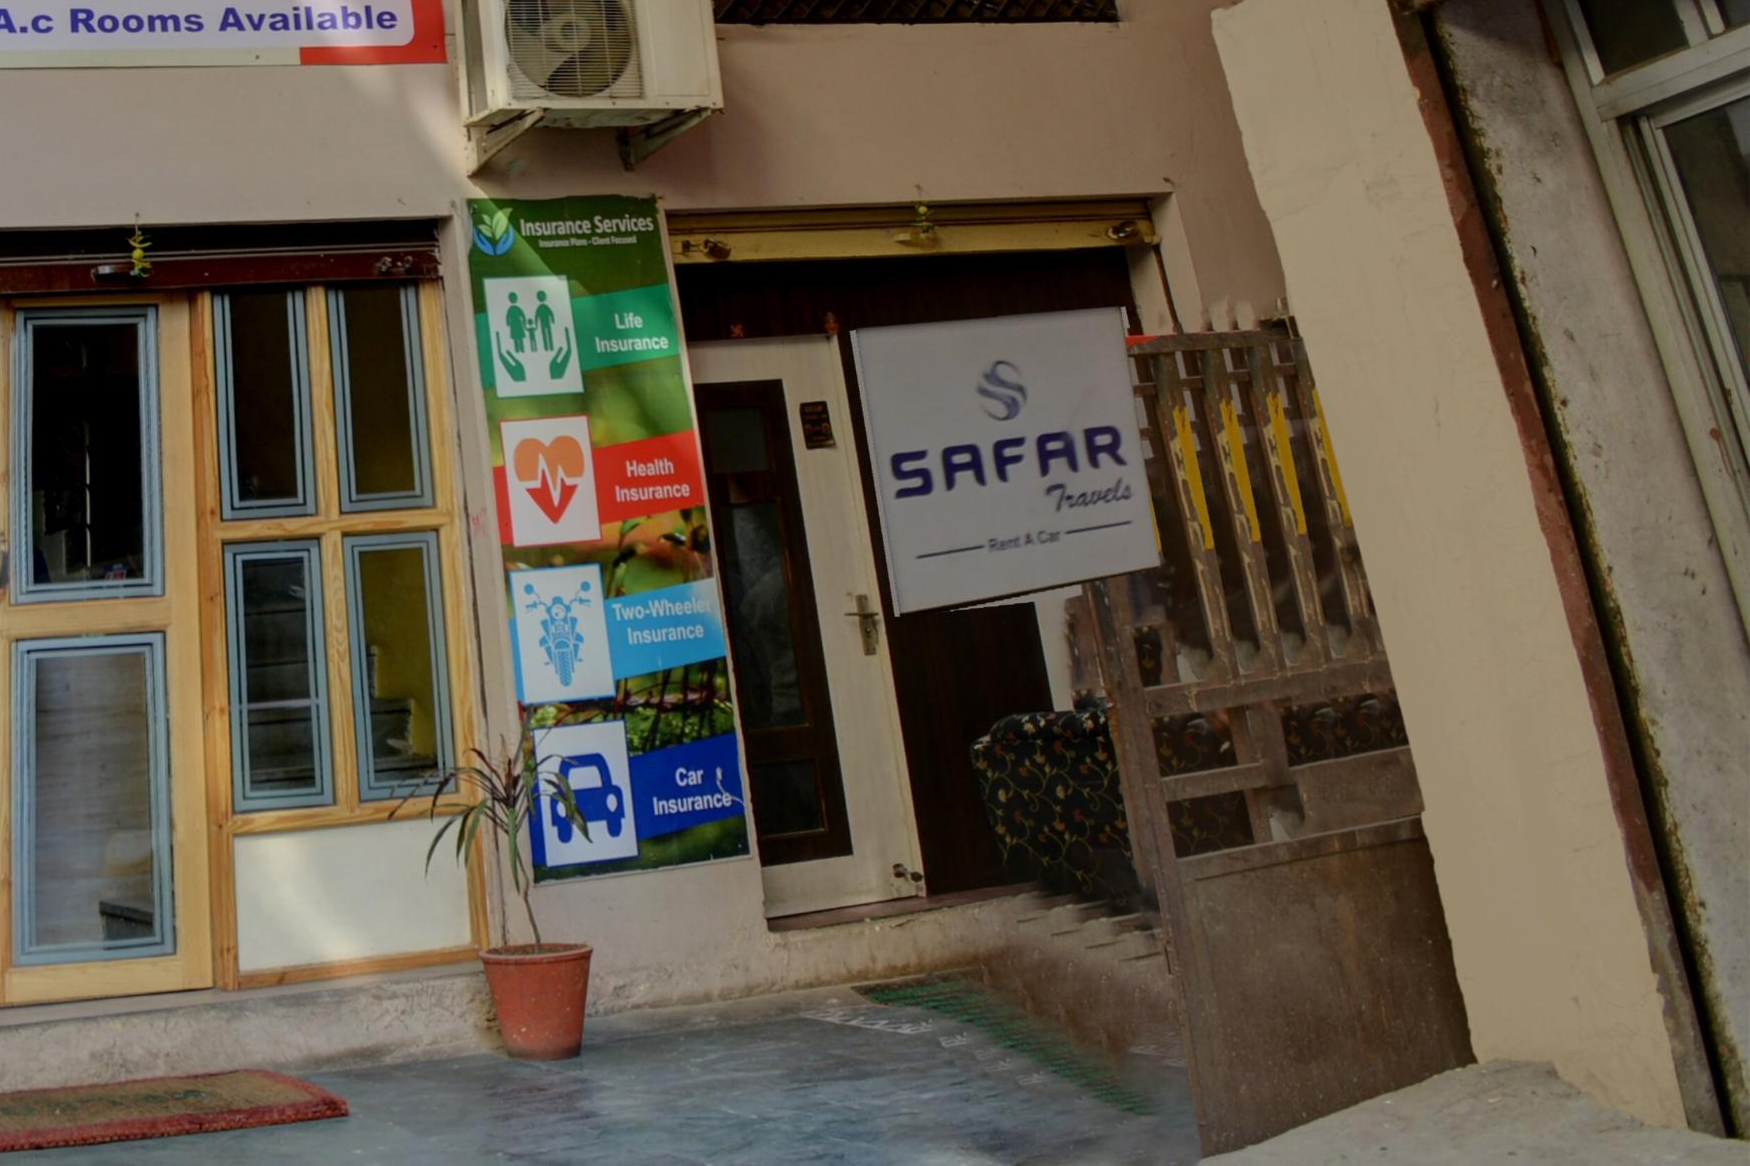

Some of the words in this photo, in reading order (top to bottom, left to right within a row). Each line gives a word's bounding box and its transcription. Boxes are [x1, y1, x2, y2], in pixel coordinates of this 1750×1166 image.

[69, 8, 205, 34] Rooms
[218, 5, 398, 32] Available
[520, 218, 592, 236] Insurance
[593, 214, 654, 233] Services
[614, 313, 643, 330] Life
[595, 335, 669, 353] Insurance
[626, 458, 675, 478] Health
[890, 425, 1129, 500] SAFAR
[615, 483, 691, 503] Insurance
[1044, 477, 1133, 513] Travels
[612, 596, 711, 621] Two-Wheeler
[627, 624, 705, 645] Insurance
[675, 767, 704, 787] Car
[652, 792, 732, 816] Insurance
